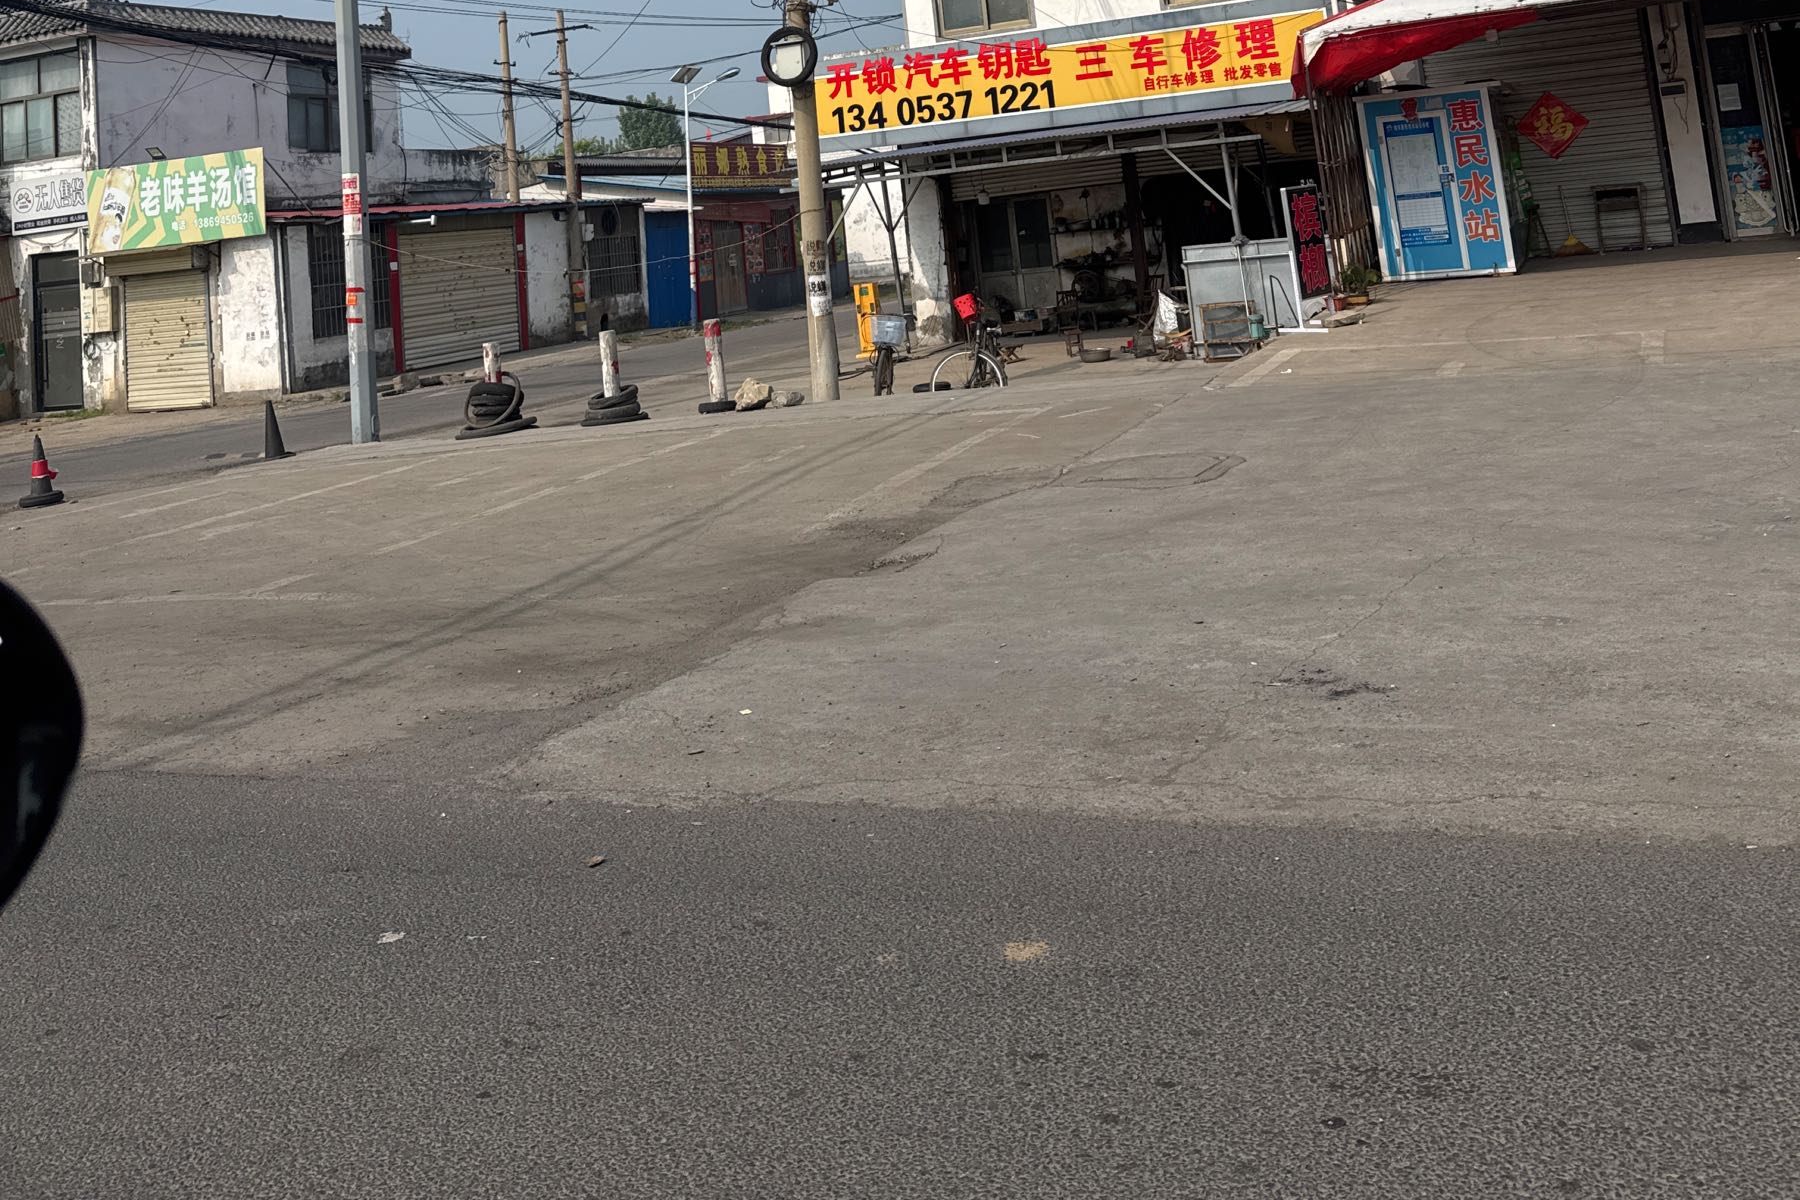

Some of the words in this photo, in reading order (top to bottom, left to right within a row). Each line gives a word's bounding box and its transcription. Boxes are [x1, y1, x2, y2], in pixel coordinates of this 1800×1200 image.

[1075, 18, 1280, 81] 三车修理
[1144, 69, 1215, 92] 自行车修理
[1223, 61, 1282, 83] 批发零售
[831, 100, 888, 134] 134
[896, 90, 973, 126] 0537
[984, 79, 1056, 115] 1221
[35, 177, 86, 212] 无人售货
[139, 162, 258, 217] 老味羊汤馆
[1446, 98, 1501, 243] 惠民水站
[1291, 192, 1329, 294] 槟榔
